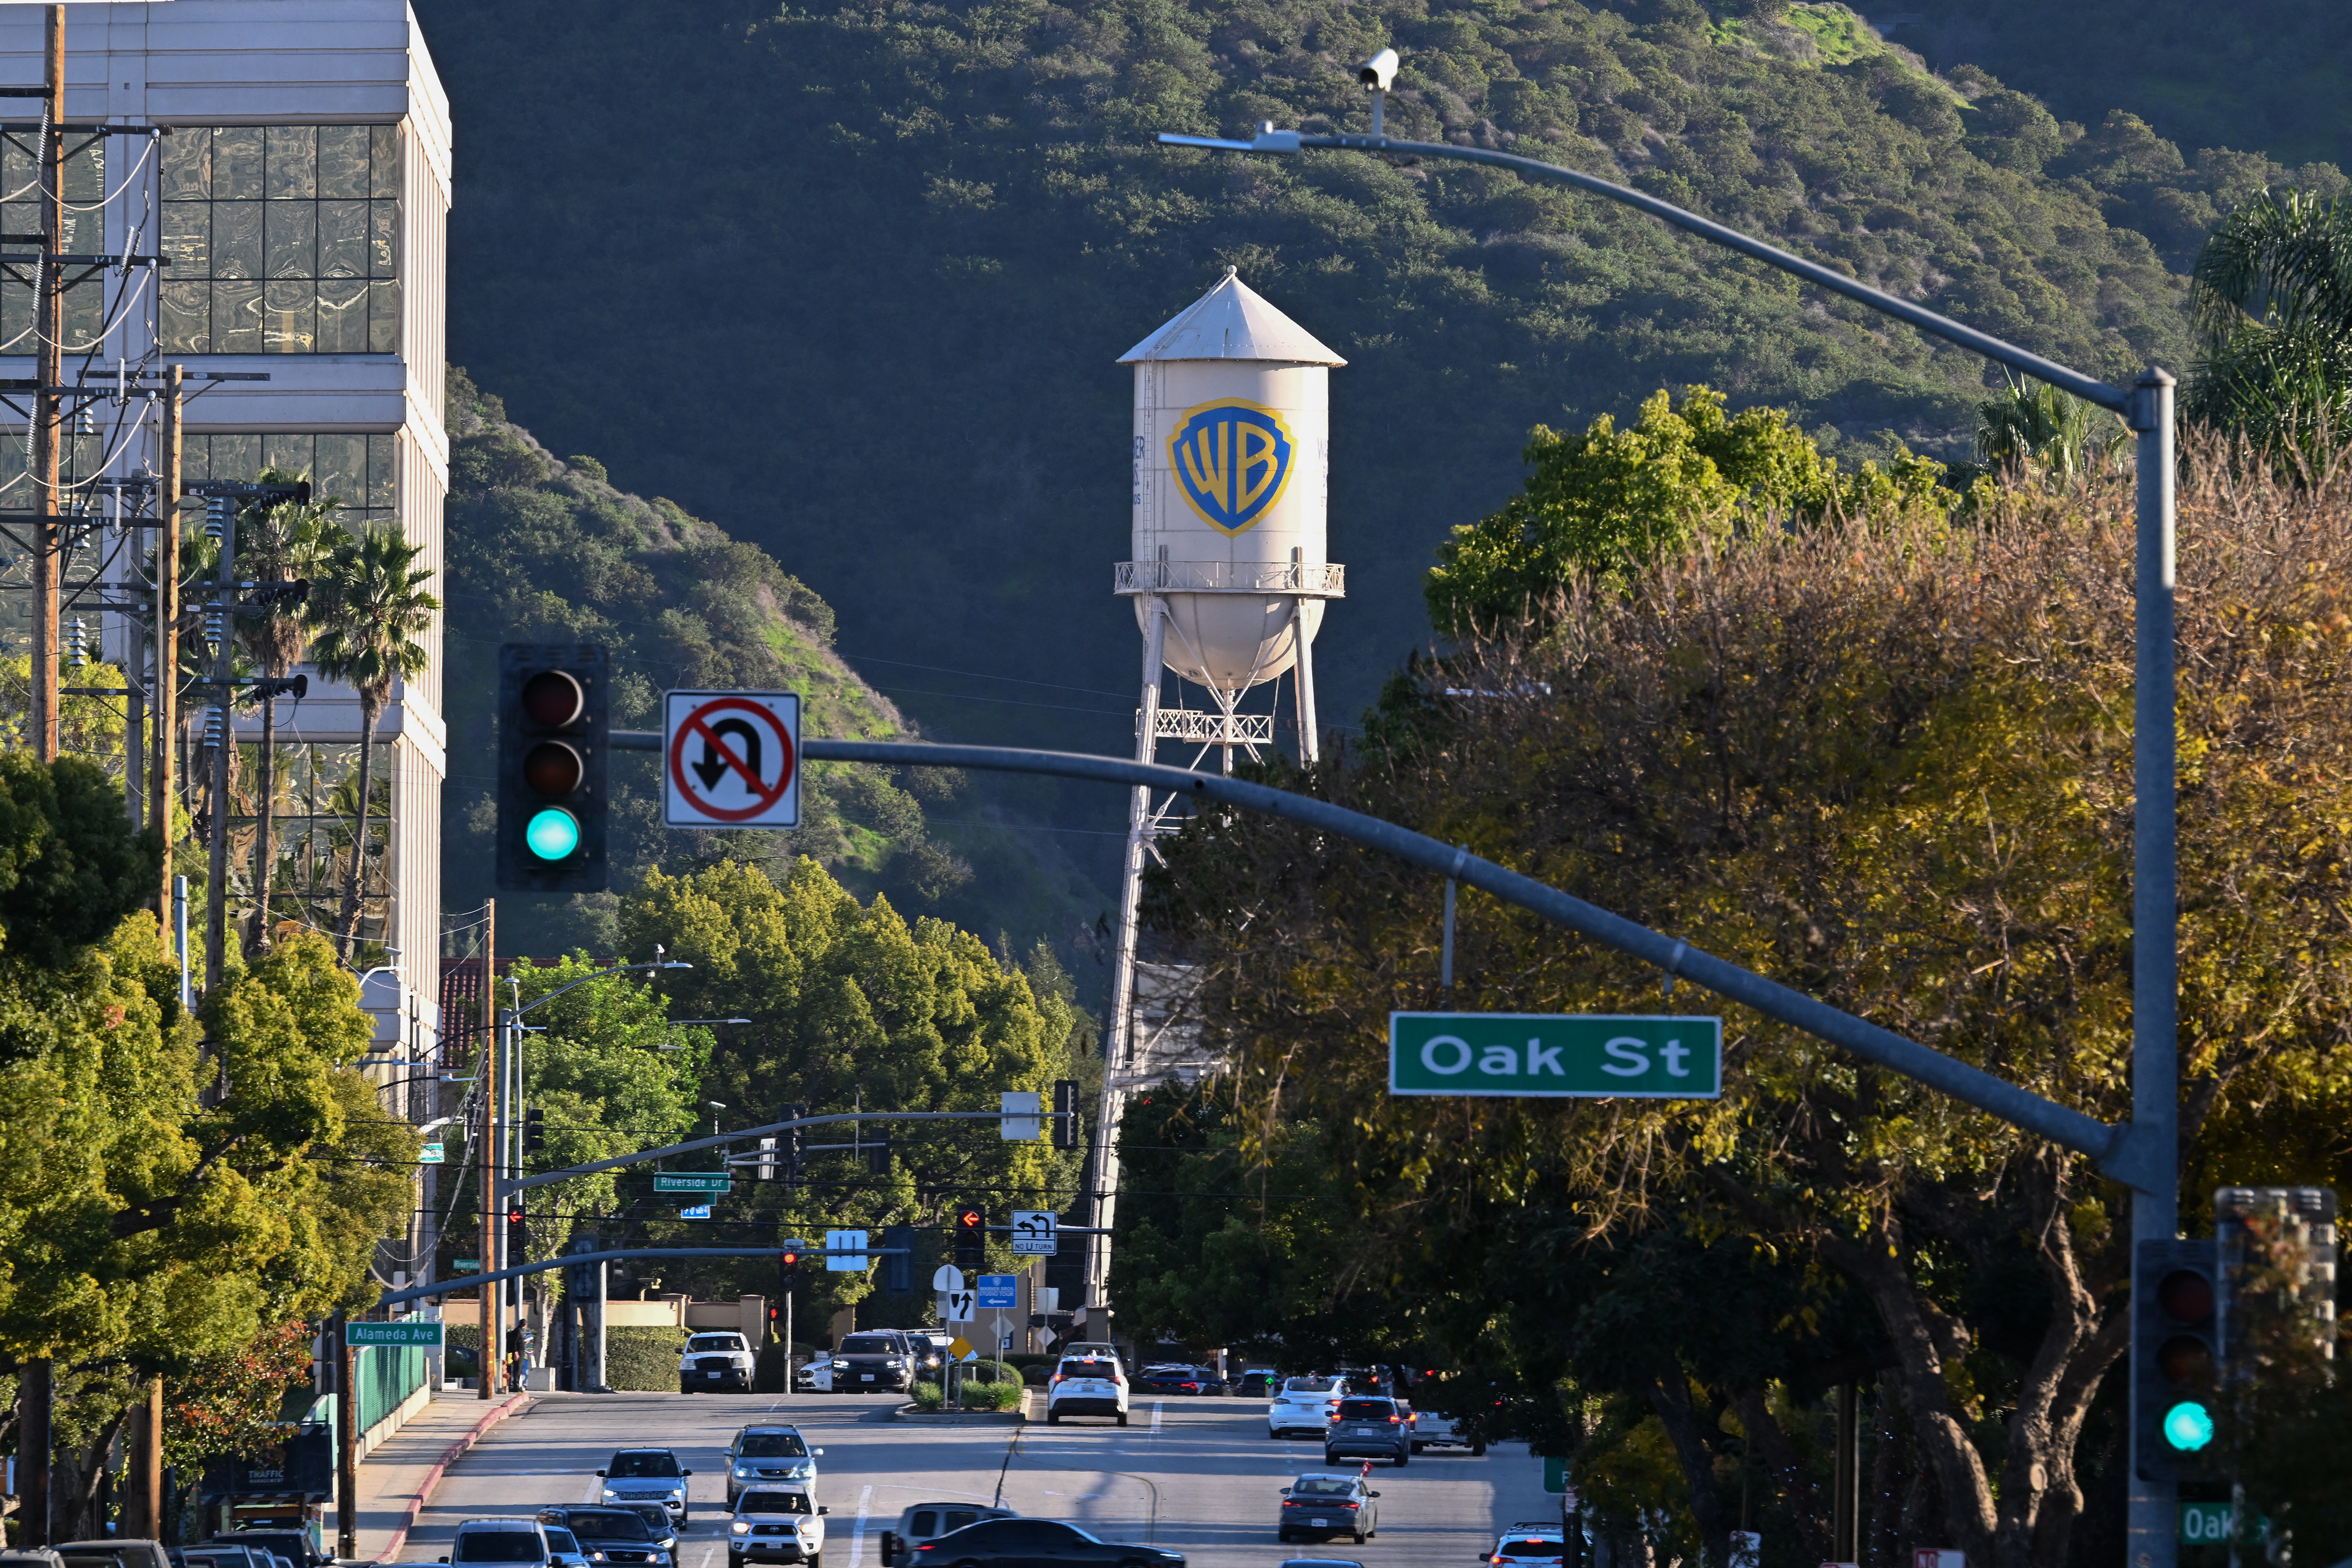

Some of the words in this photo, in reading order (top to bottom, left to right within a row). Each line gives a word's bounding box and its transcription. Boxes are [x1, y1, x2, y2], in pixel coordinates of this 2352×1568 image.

[1182, 421, 1278, 515] WB
[1419, 1035, 1565, 1076] Oak
[1600, 1037, 1691, 1077] St
[661, 1177, 706, 1186] Riverside
[711, 1178, 723, 1186] Dr
[355, 1328, 406, 1340] Alameda
[413, 1328, 434, 1340] Ave
[249, 1470, 284, 1478] TRAFFIC
[2186, 1508, 2233, 1539] Oak
